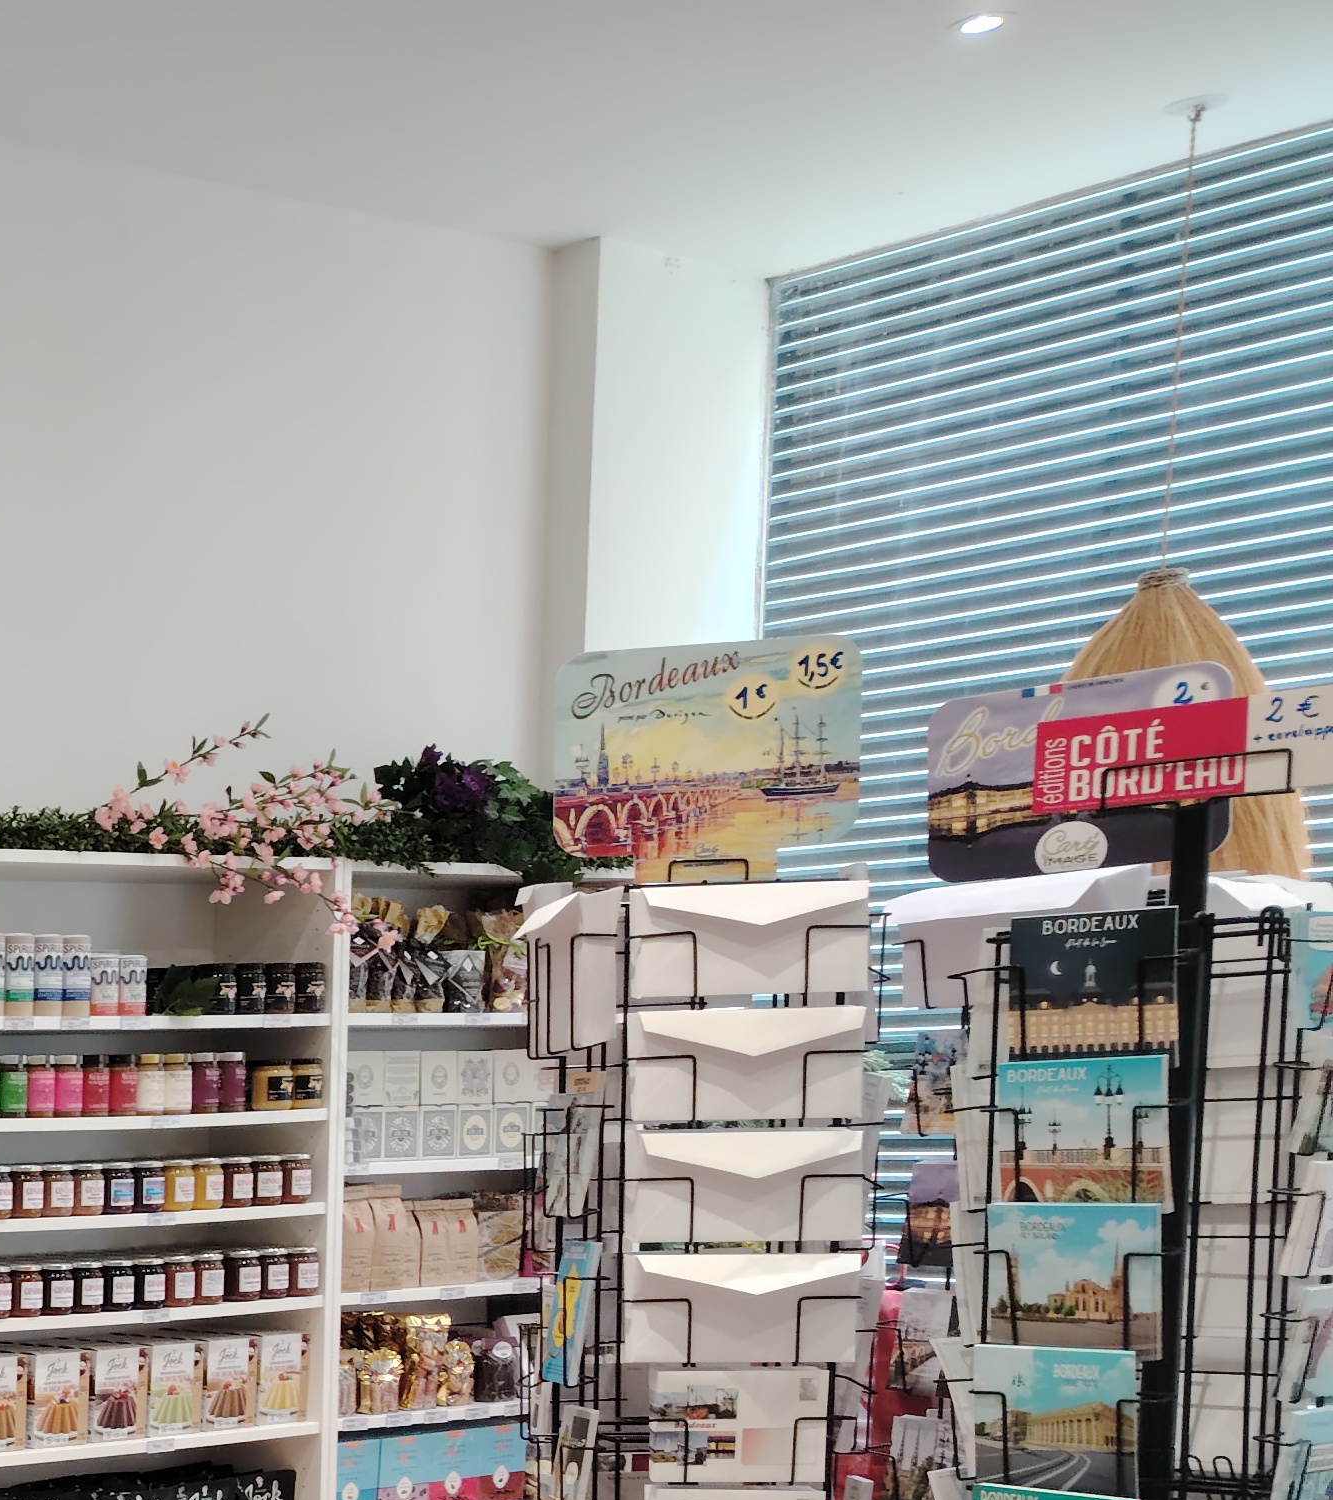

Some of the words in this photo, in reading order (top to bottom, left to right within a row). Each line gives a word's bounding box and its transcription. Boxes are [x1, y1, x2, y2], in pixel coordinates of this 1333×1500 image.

[571, 651, 740, 719] Bordeaux
[1173, 681, 1194, 704] 2
[735, 686, 749, 709] 1
[1265, 697, 1285, 722] 2
[1070, 718, 1166, 768] CÔTÉ
[1036, 737, 1068, 805] éditions
[1044, 852, 1099, 868] IMAGE
[1042, 914, 1140, 935] BORDEAUX
[1006, 1066, 1087, 1083] BORDEAUX
[1019, 1221, 1065, 1233] BORDEAUX
[162, 1352, 185, 1372] Jock
[218, 1347, 240, 1368] Jock
[272, 1342, 292, 1362] Jock
[46, 1361, 70, 1381] Jock
[106, 1357, 129, 1376] Jock
